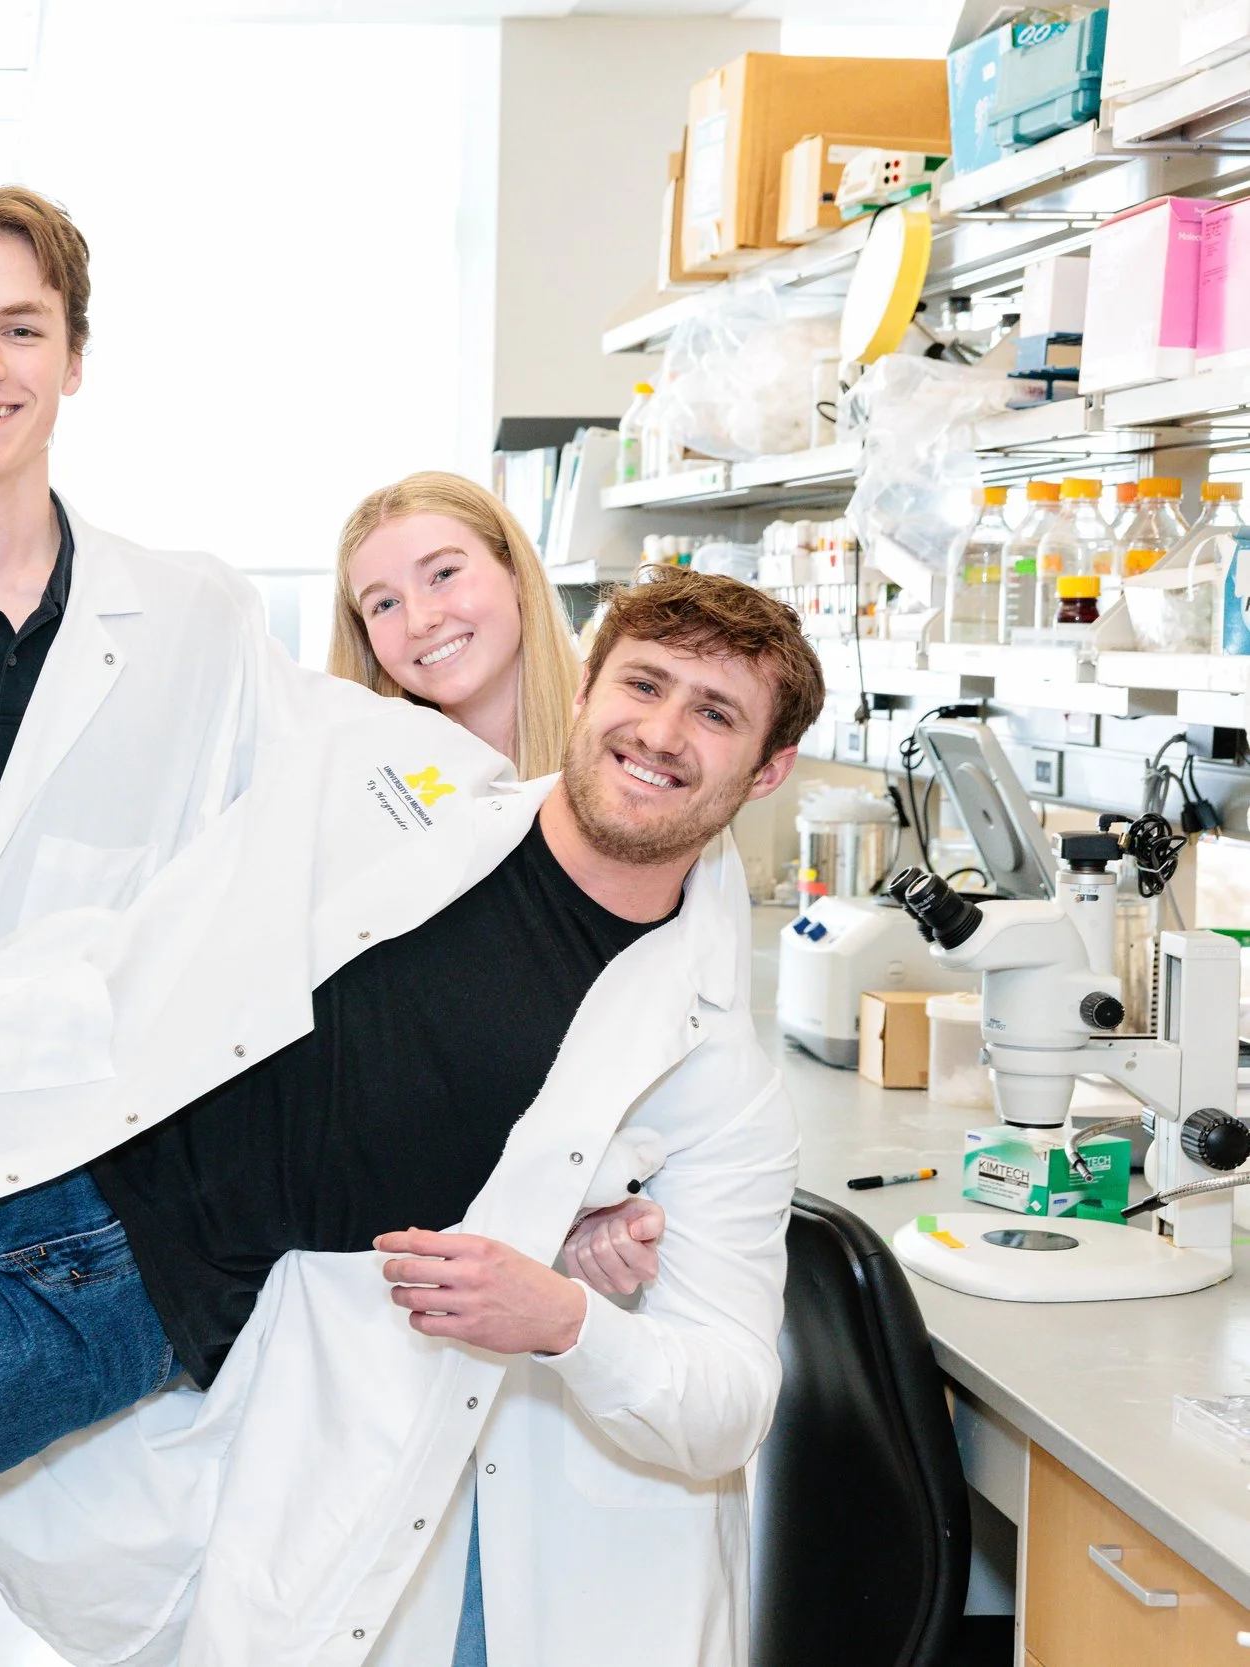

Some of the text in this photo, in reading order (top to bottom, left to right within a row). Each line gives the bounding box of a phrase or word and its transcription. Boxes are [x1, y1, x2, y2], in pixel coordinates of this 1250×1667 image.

[383, 765, 409, 796] UNIVERSITY
[409, 800, 434, 827] MICHIGAN
[403, 765, 456, 808] M
[978, 1160, 1030, 1182] KIMTECH
